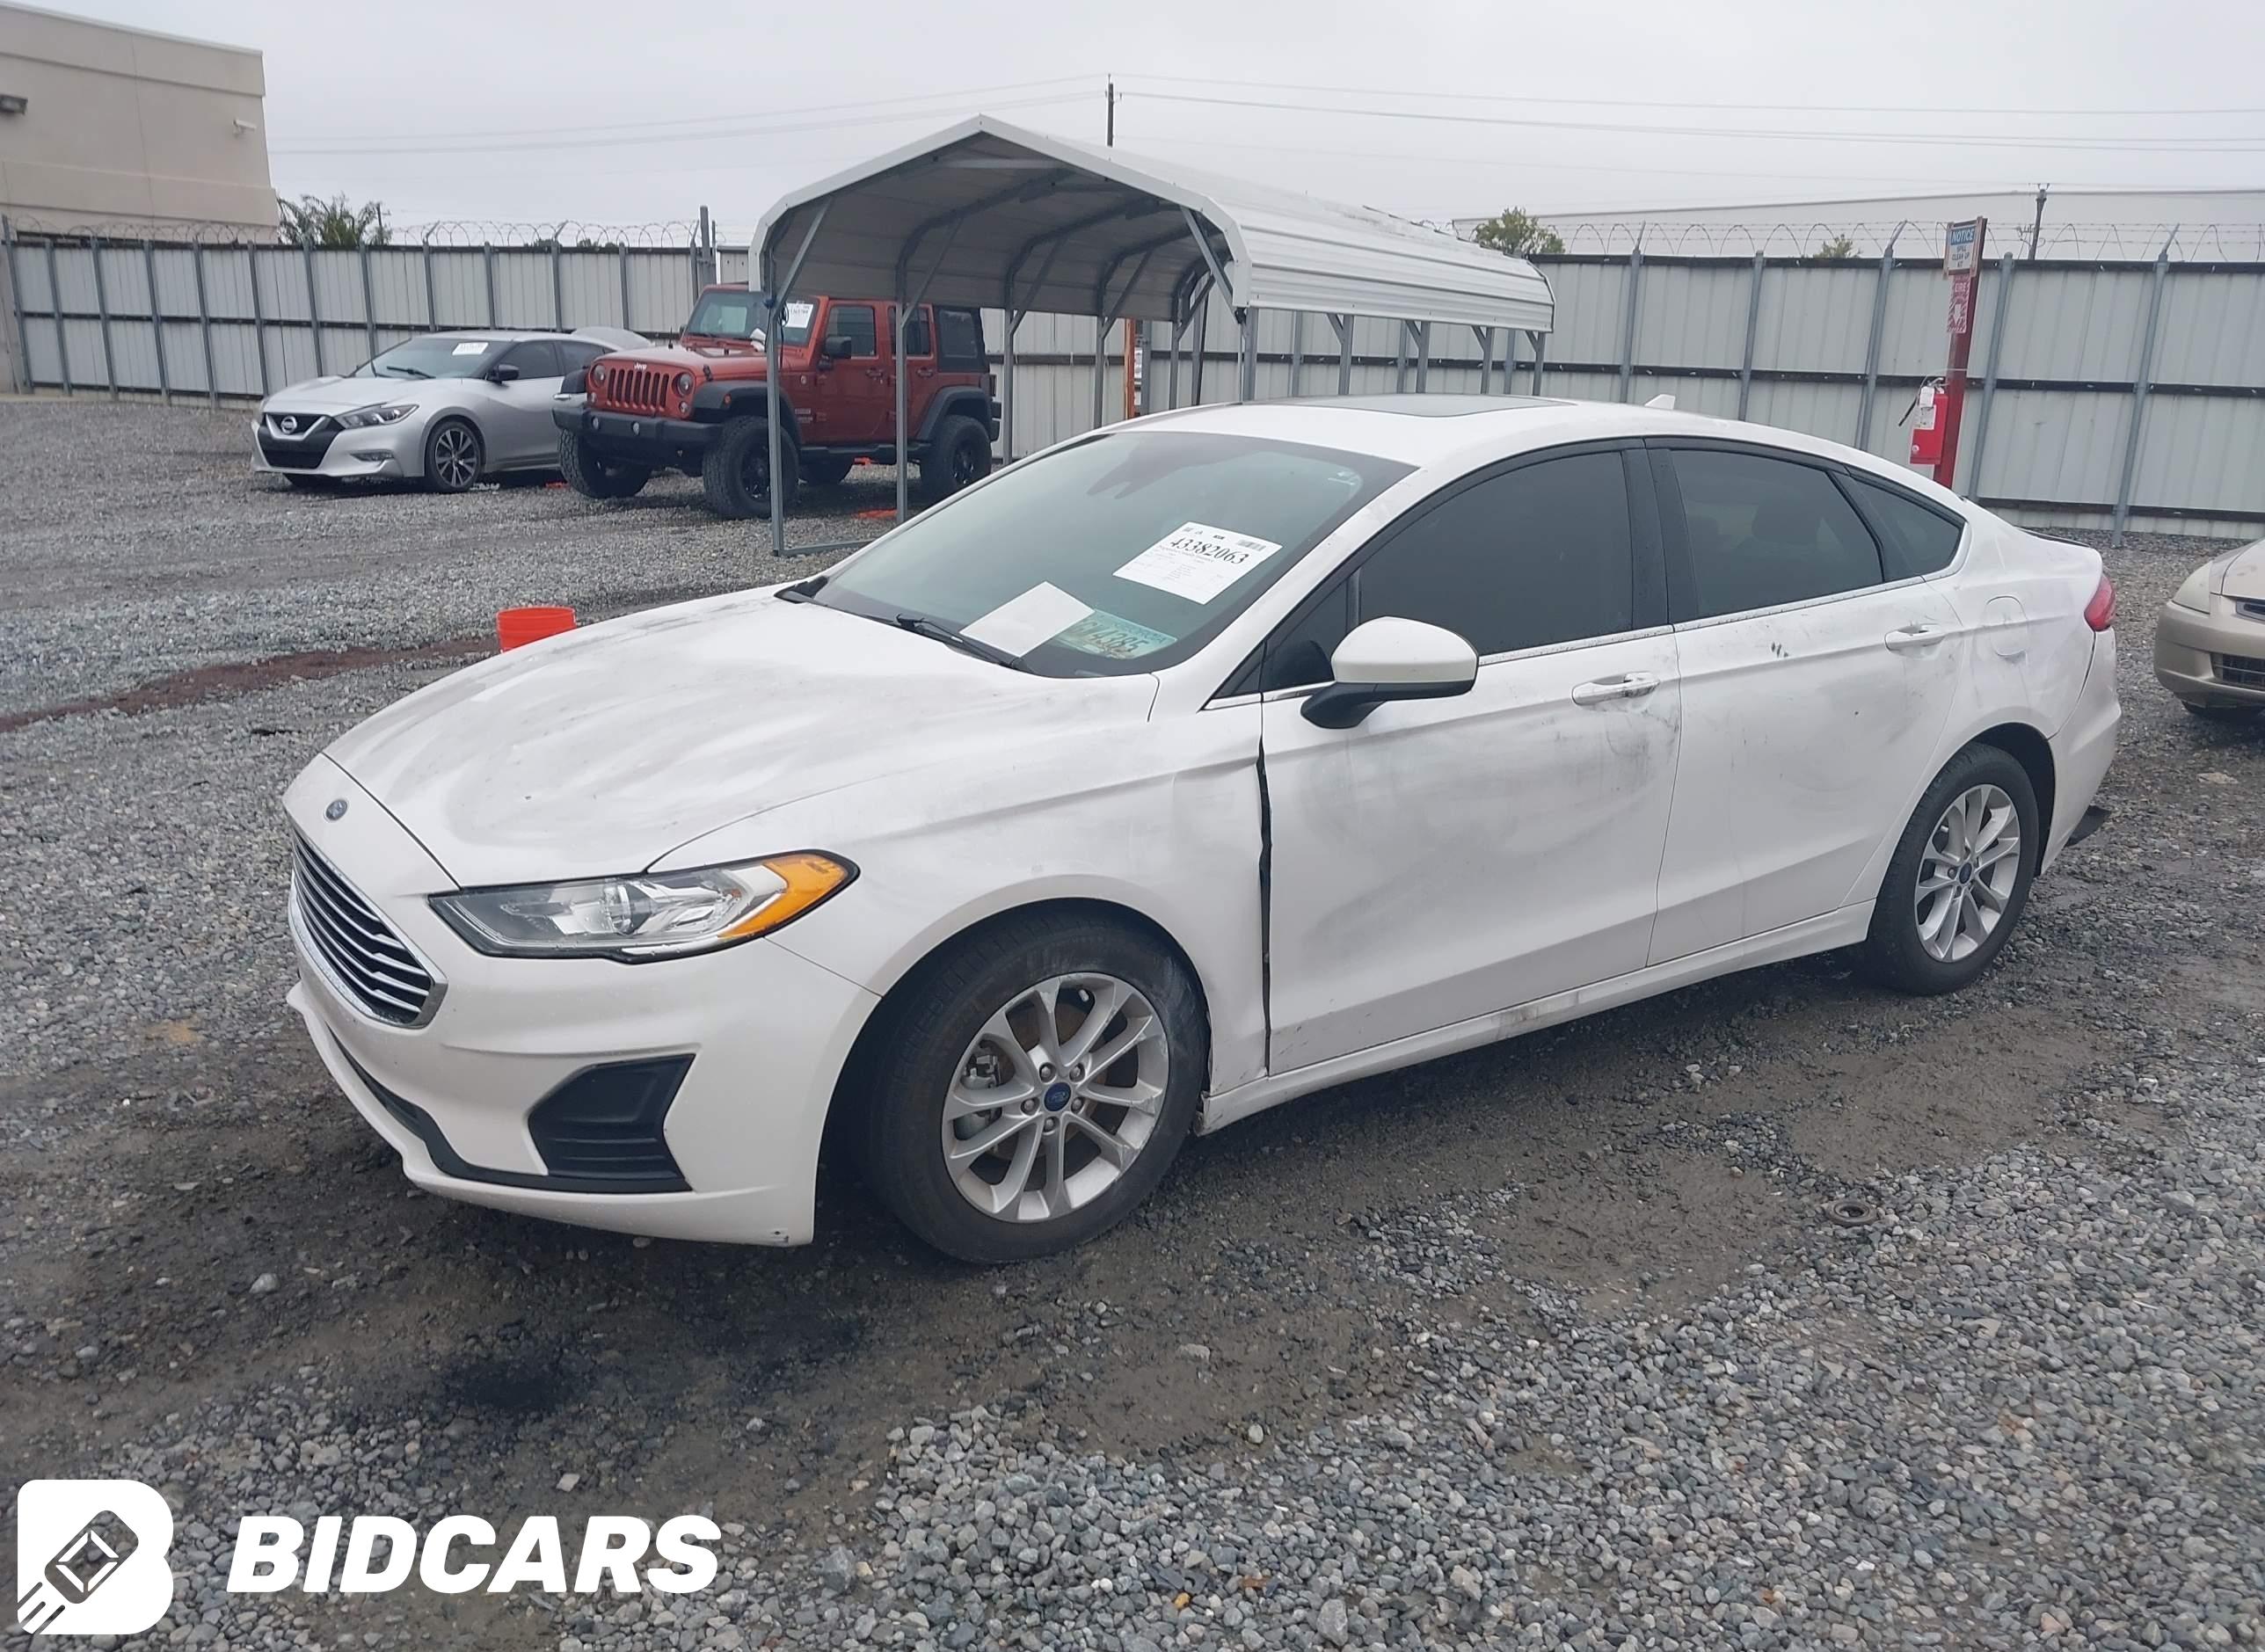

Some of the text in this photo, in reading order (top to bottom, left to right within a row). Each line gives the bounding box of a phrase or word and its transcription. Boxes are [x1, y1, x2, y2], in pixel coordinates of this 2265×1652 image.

[1952, 229, 1975, 243] NOTICE
[1955, 282, 1966, 293] FIRE
[1169, 537, 1249, 564] 43382063
